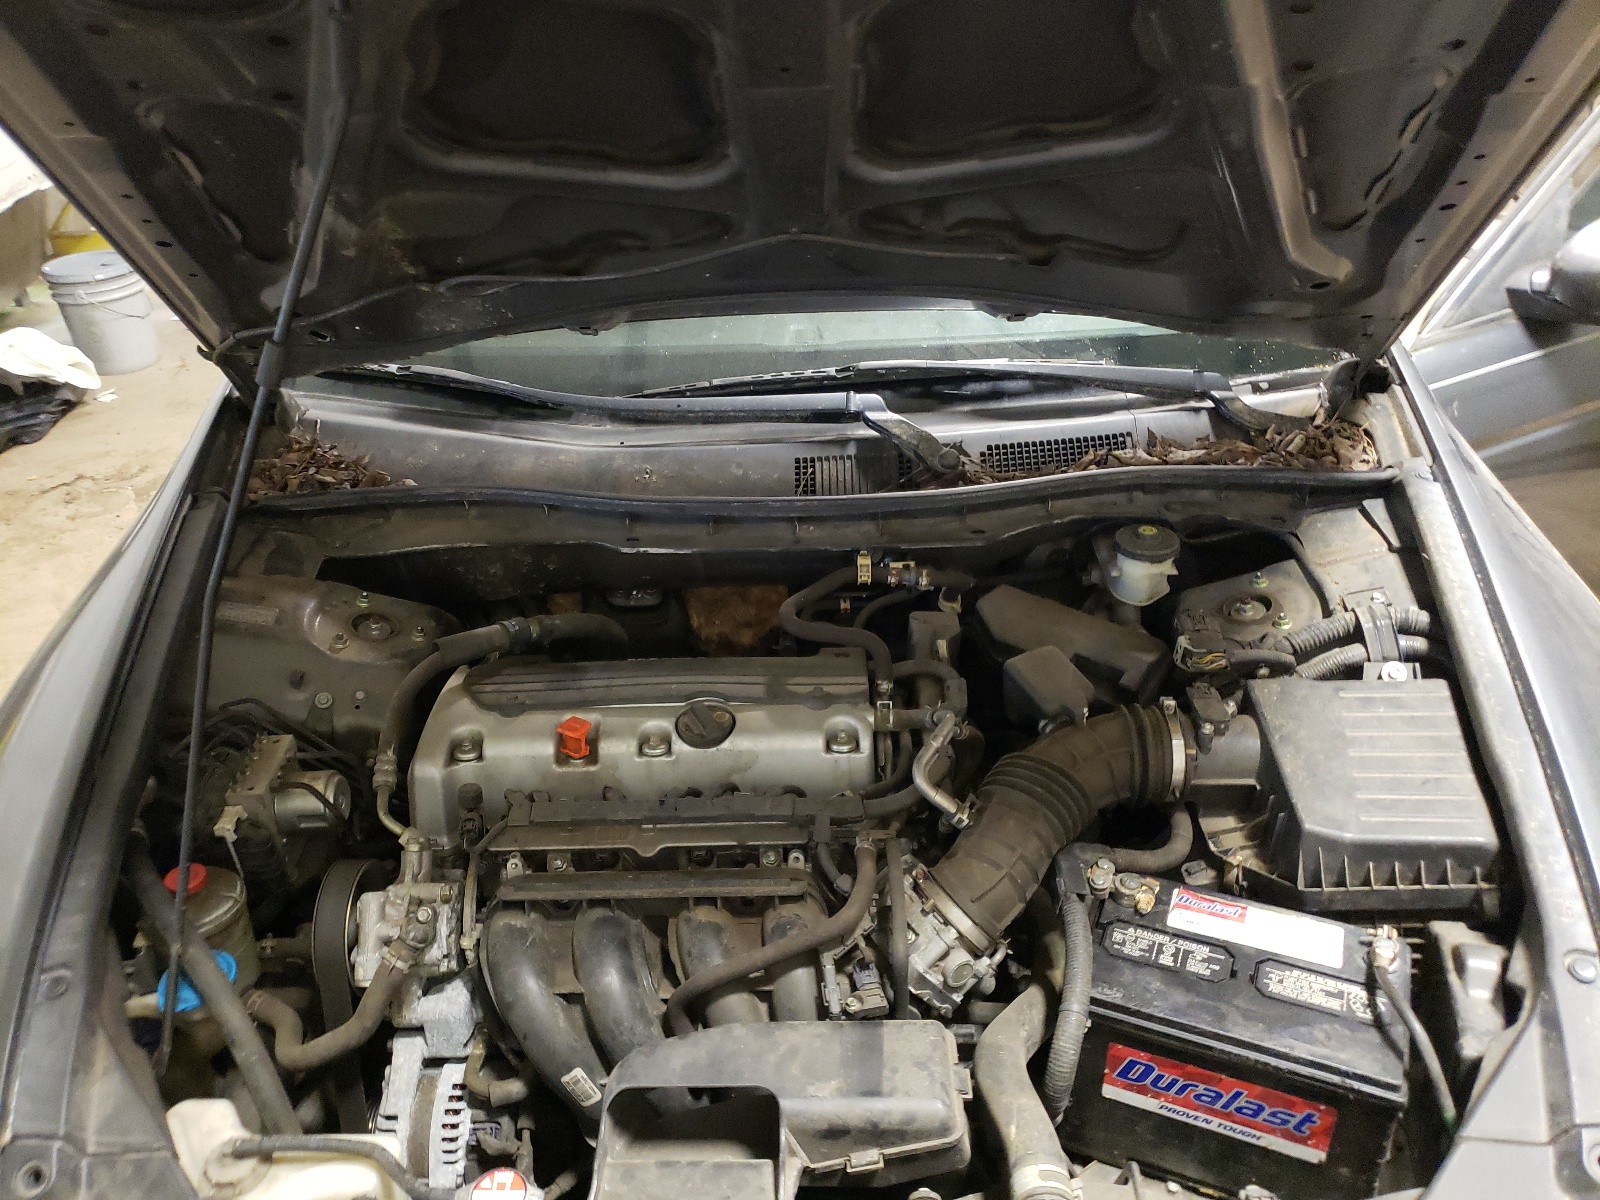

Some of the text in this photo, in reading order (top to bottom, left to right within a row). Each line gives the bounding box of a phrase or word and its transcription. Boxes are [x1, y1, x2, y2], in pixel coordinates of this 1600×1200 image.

[1178, 894, 1241, 918] Duralast
[1136, 928, 1170, 944] DANGER
[1177, 939, 1210, 954] POISON
[1112, 1056, 1322, 1137] Duralast
[1158, 1104, 1263, 1141] PROVEN TOUGH
